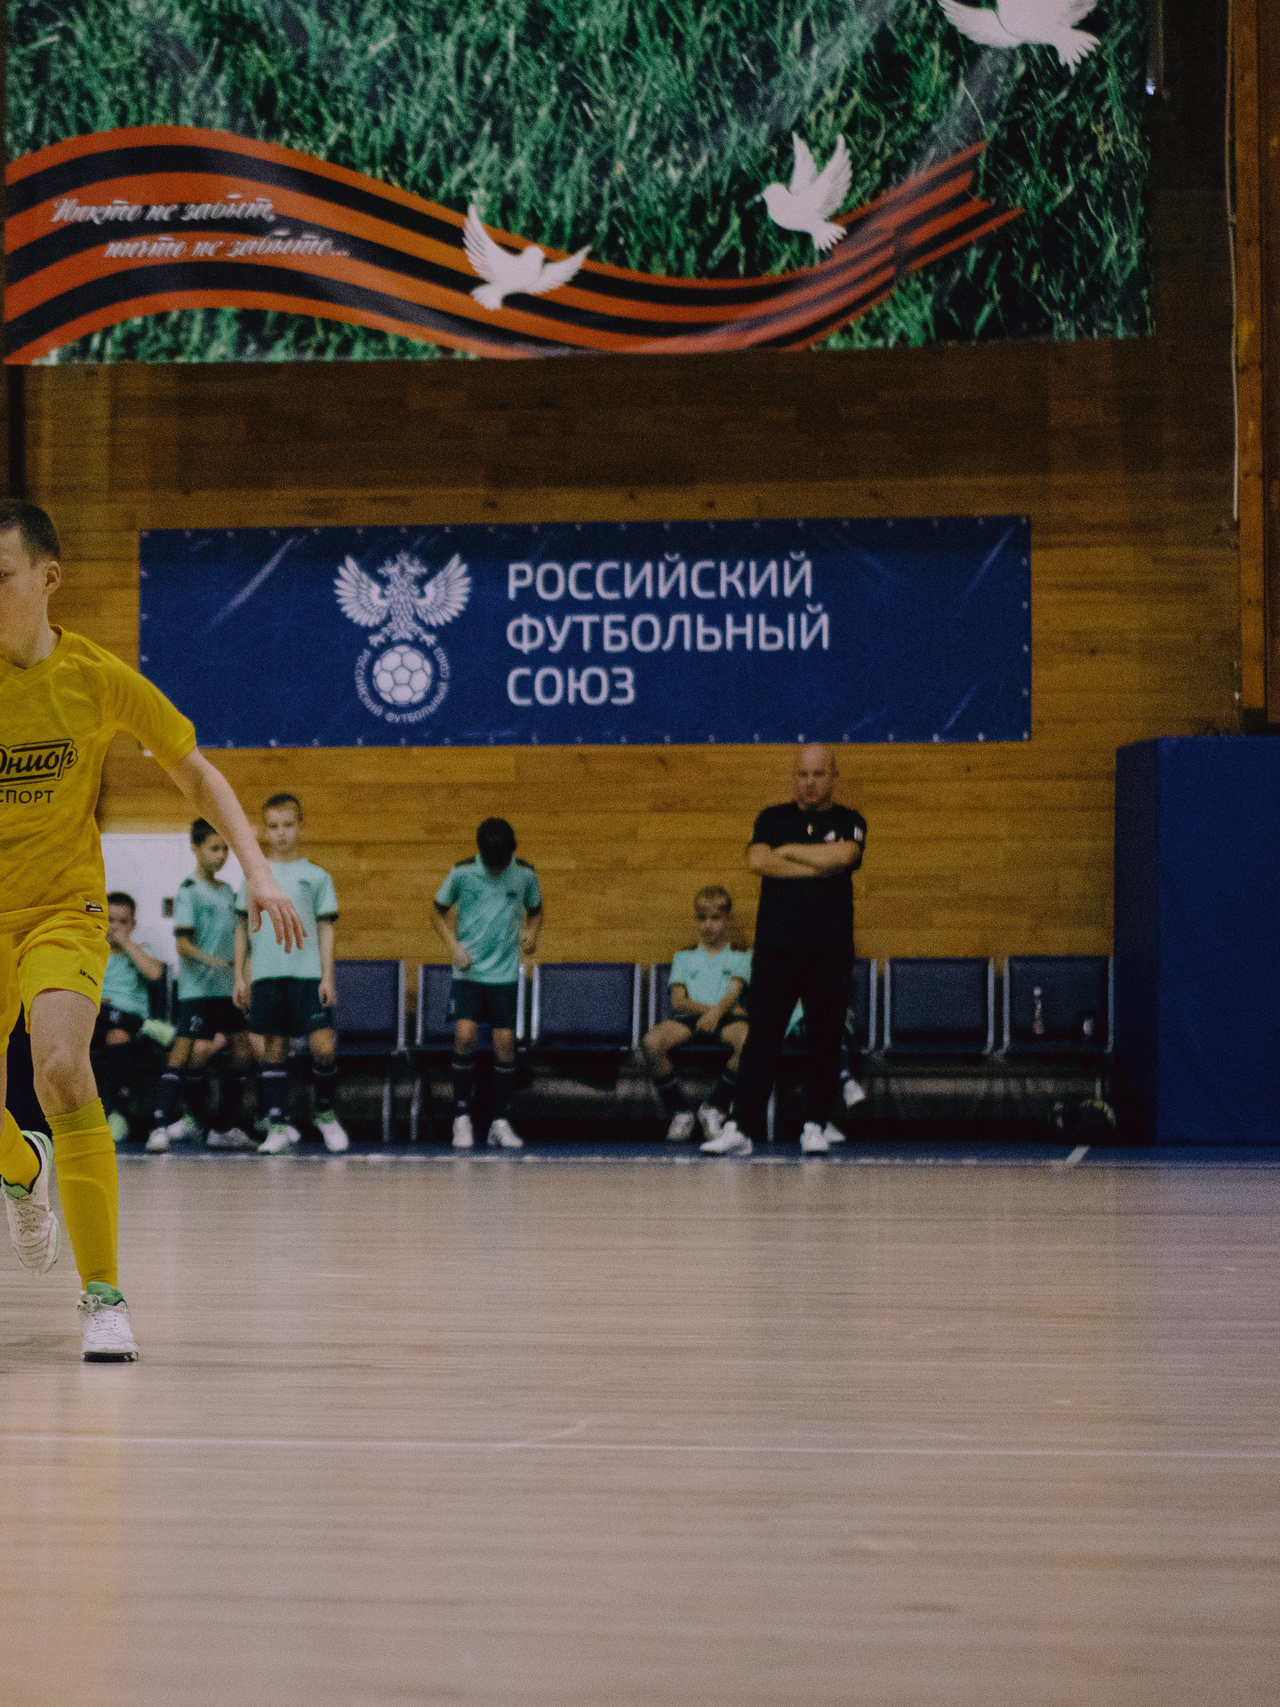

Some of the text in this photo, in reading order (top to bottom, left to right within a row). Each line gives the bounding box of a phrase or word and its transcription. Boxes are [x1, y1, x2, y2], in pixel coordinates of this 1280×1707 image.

[507, 551, 814, 601] РОССИЙСКИЙ
[506, 603, 831, 655] ФУТБОЛЬНЫЙ
[506, 666, 636, 706] СОЮЗ
